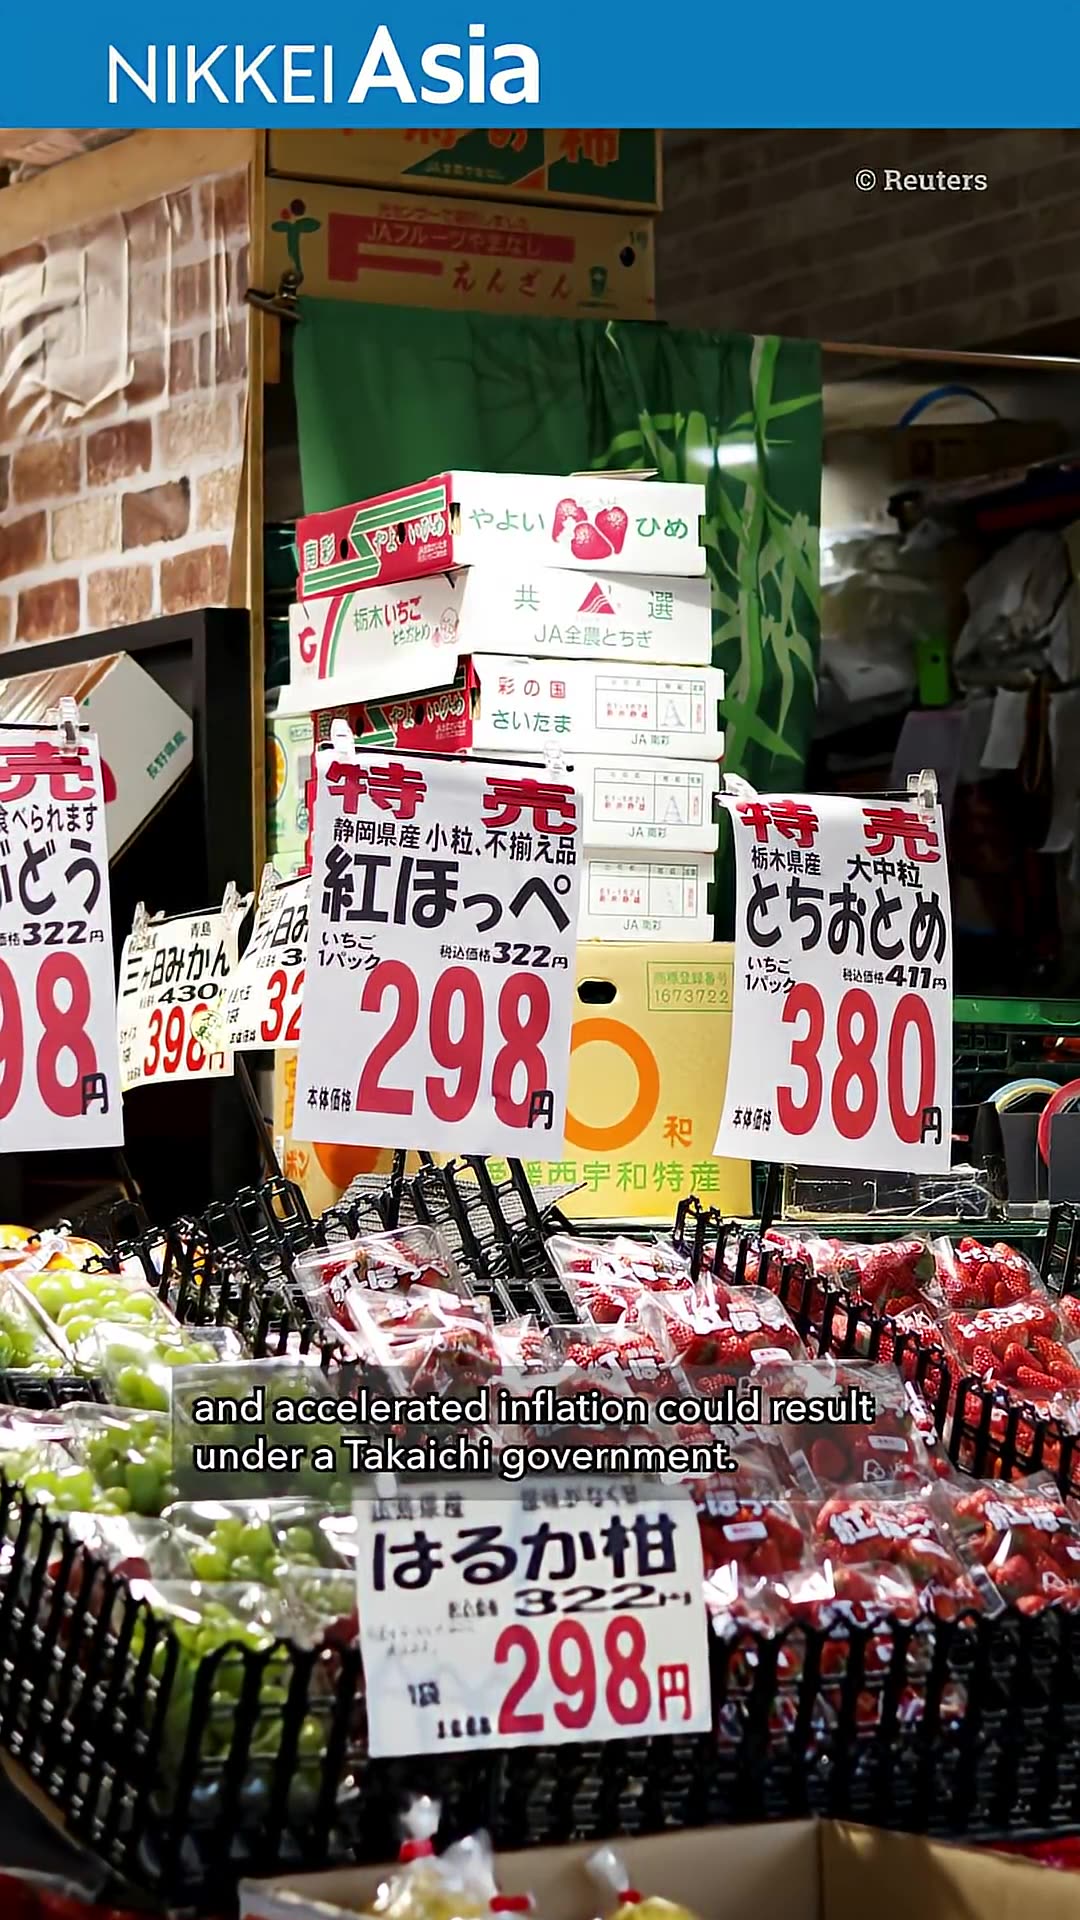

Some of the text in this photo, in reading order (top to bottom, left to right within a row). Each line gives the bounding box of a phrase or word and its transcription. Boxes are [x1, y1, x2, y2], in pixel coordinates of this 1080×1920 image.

[367, 219, 543, 257] JAフルーツやまなし
[468, 508, 689, 540] やよい ひめ
[353, 596, 423, 632] 栃木いちご
[514, 583, 674, 621] 共 選
[534, 624, 653, 649] JA全農とちぎ
[499, 676, 567, 700] 彩の国
[491, 709, 573, 734] さいたま
[325, 760, 428, 821] 特
[479, 778, 578, 836] 売
[332, 817, 421, 850] 静岡県産
[735, 799, 941, 864] 特 売
[751, 845, 923, 890] 栃木県産 大中粒
[321, 843, 572, 934] 紅ほっぺ
[746, 872, 947, 965] とちおとめ
[322, 931, 377, 951] いちご
[317, 949, 382, 972] 1パック
[747, 955, 793, 976] いちご
[654, 988, 729, 1005] 1673722
[744, 974, 796, 995] 1パック
[356, 959, 554, 1130] 298円
[776, 982, 943, 1145] 380円
[306, 1085, 352, 1113] 本体価格
[732, 1105, 772, 1133] 本体価格
[372, 1512, 677, 1592] はるか柑
[494, 1615, 693, 1735] 298円
